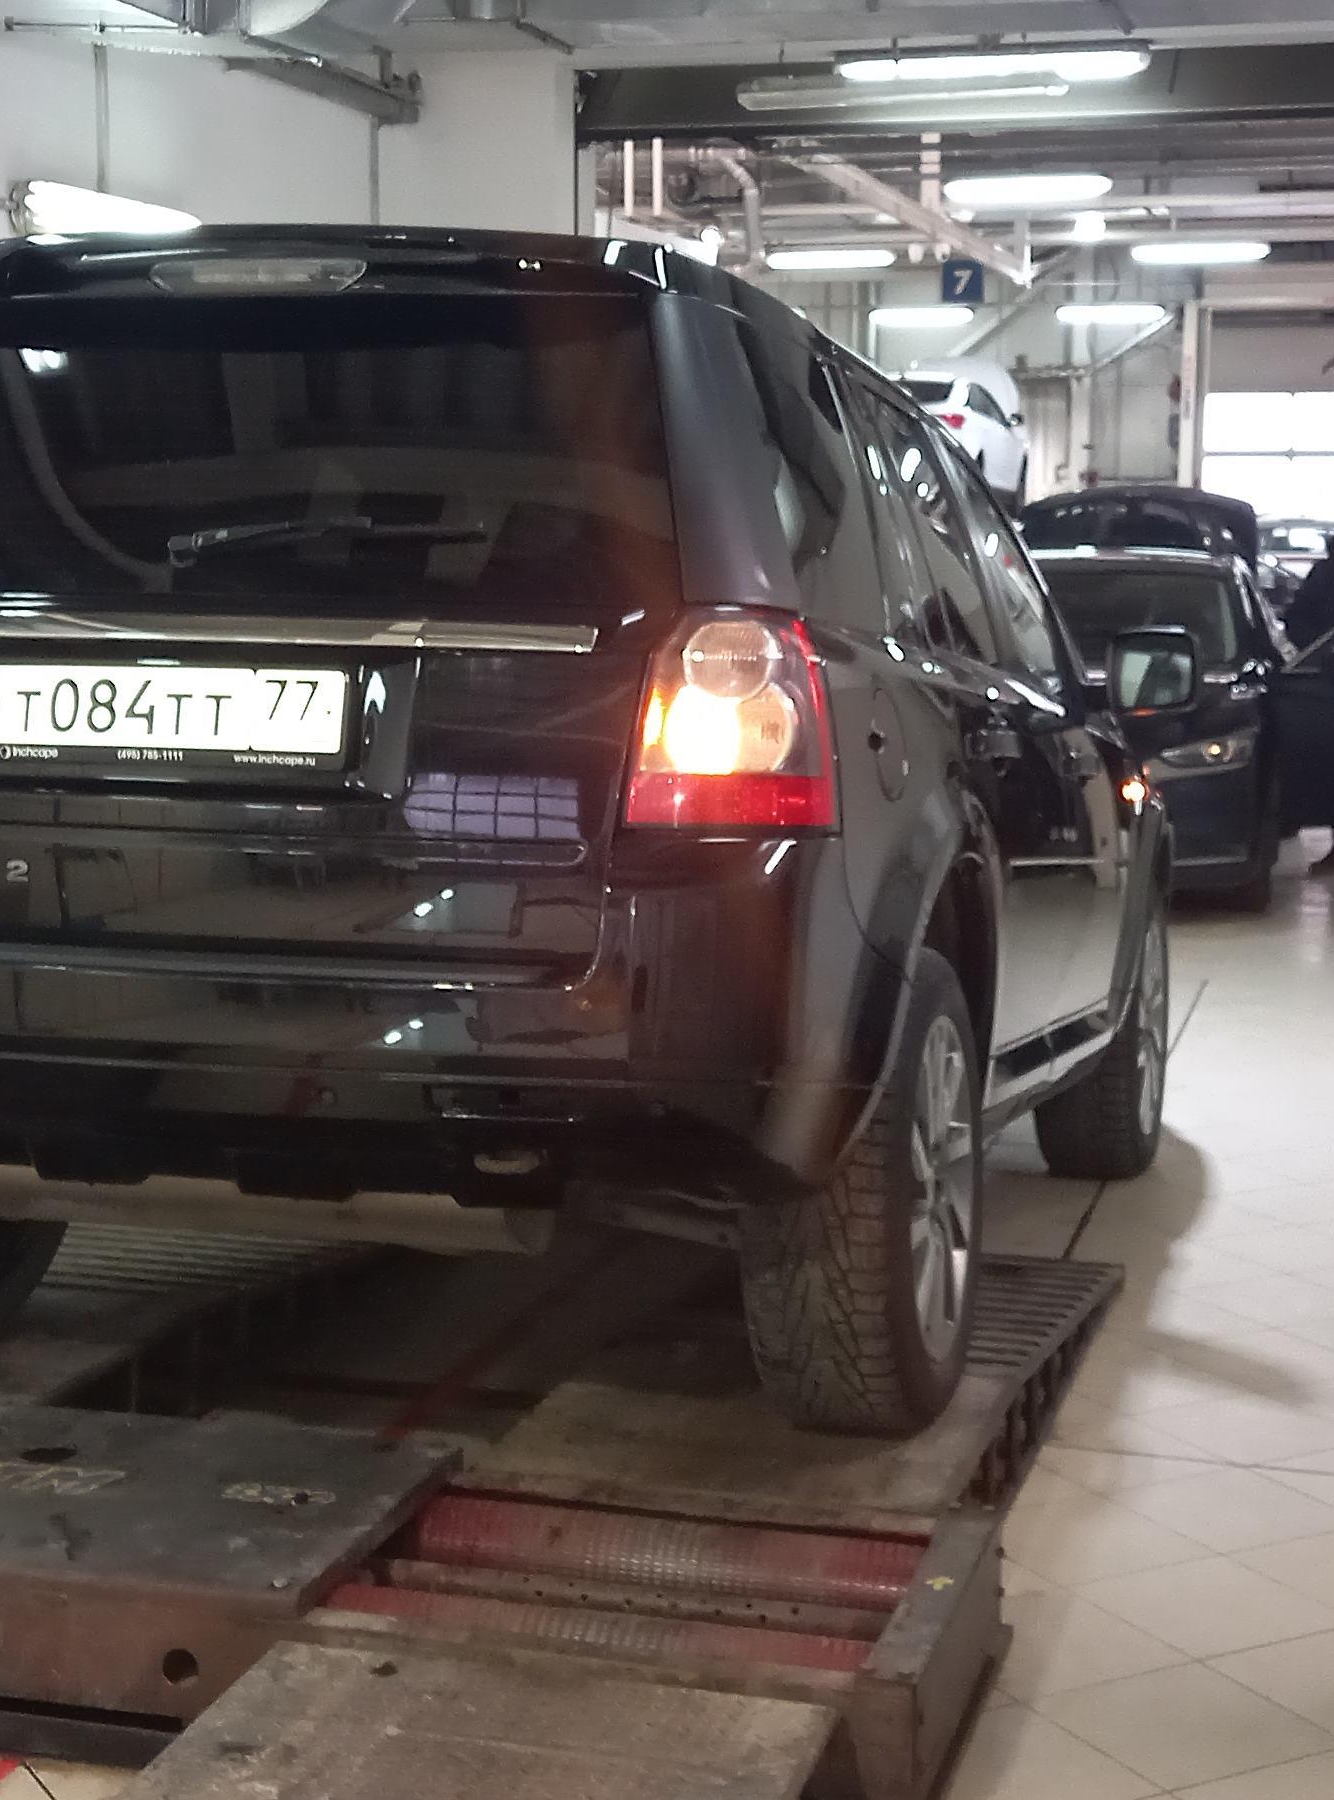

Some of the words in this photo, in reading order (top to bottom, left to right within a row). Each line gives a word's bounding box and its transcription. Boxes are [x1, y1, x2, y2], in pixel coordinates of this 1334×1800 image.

[954, 269, 974, 295] 7
[266, 680, 318, 719] 77
[233, 753, 316, 767] www.inchcape.ru
[6, 858, 29, 882] 2
